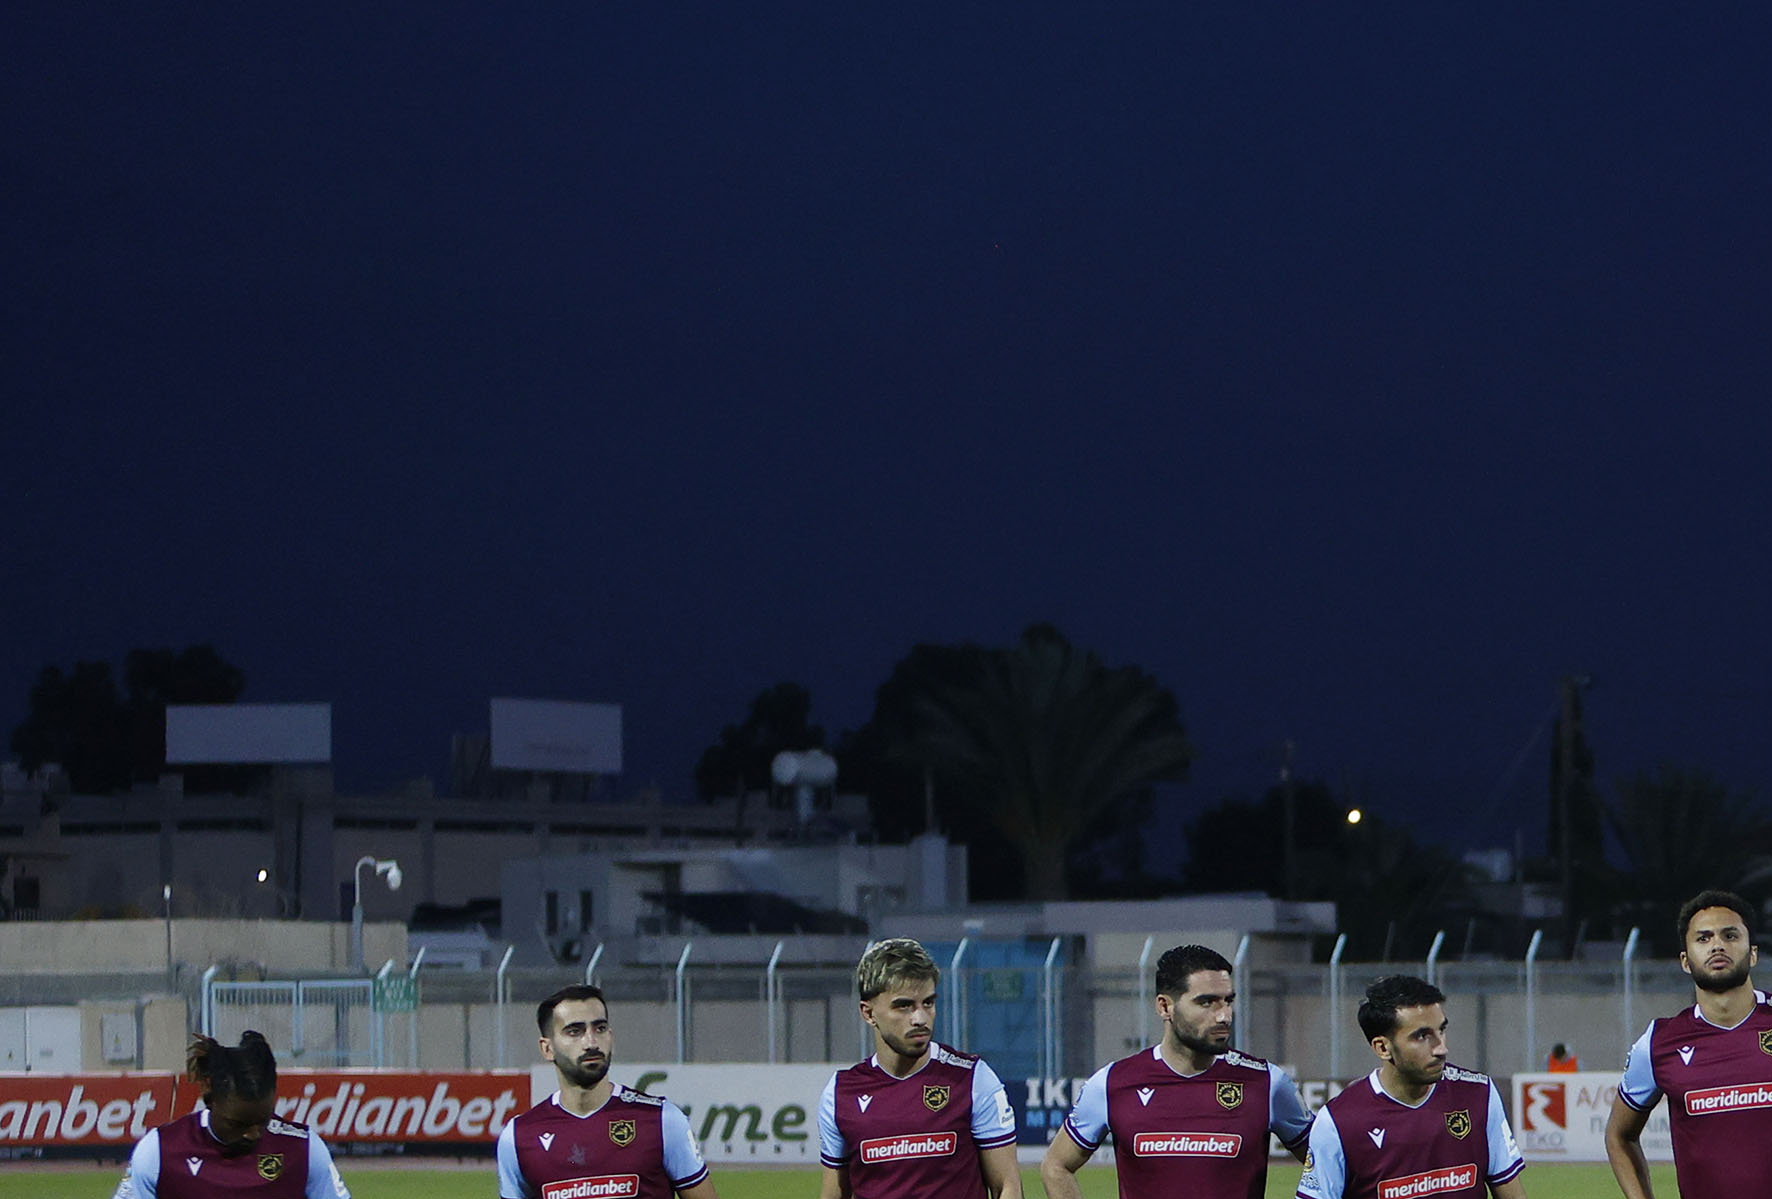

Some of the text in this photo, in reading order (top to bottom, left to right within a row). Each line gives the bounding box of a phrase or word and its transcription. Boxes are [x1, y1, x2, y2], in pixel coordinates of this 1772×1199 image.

[866, 1137, 951, 1159] meridianbet
[1138, 1136, 1237, 1154] meridianbet
[1383, 1168, 1472, 1199] meridianbet
